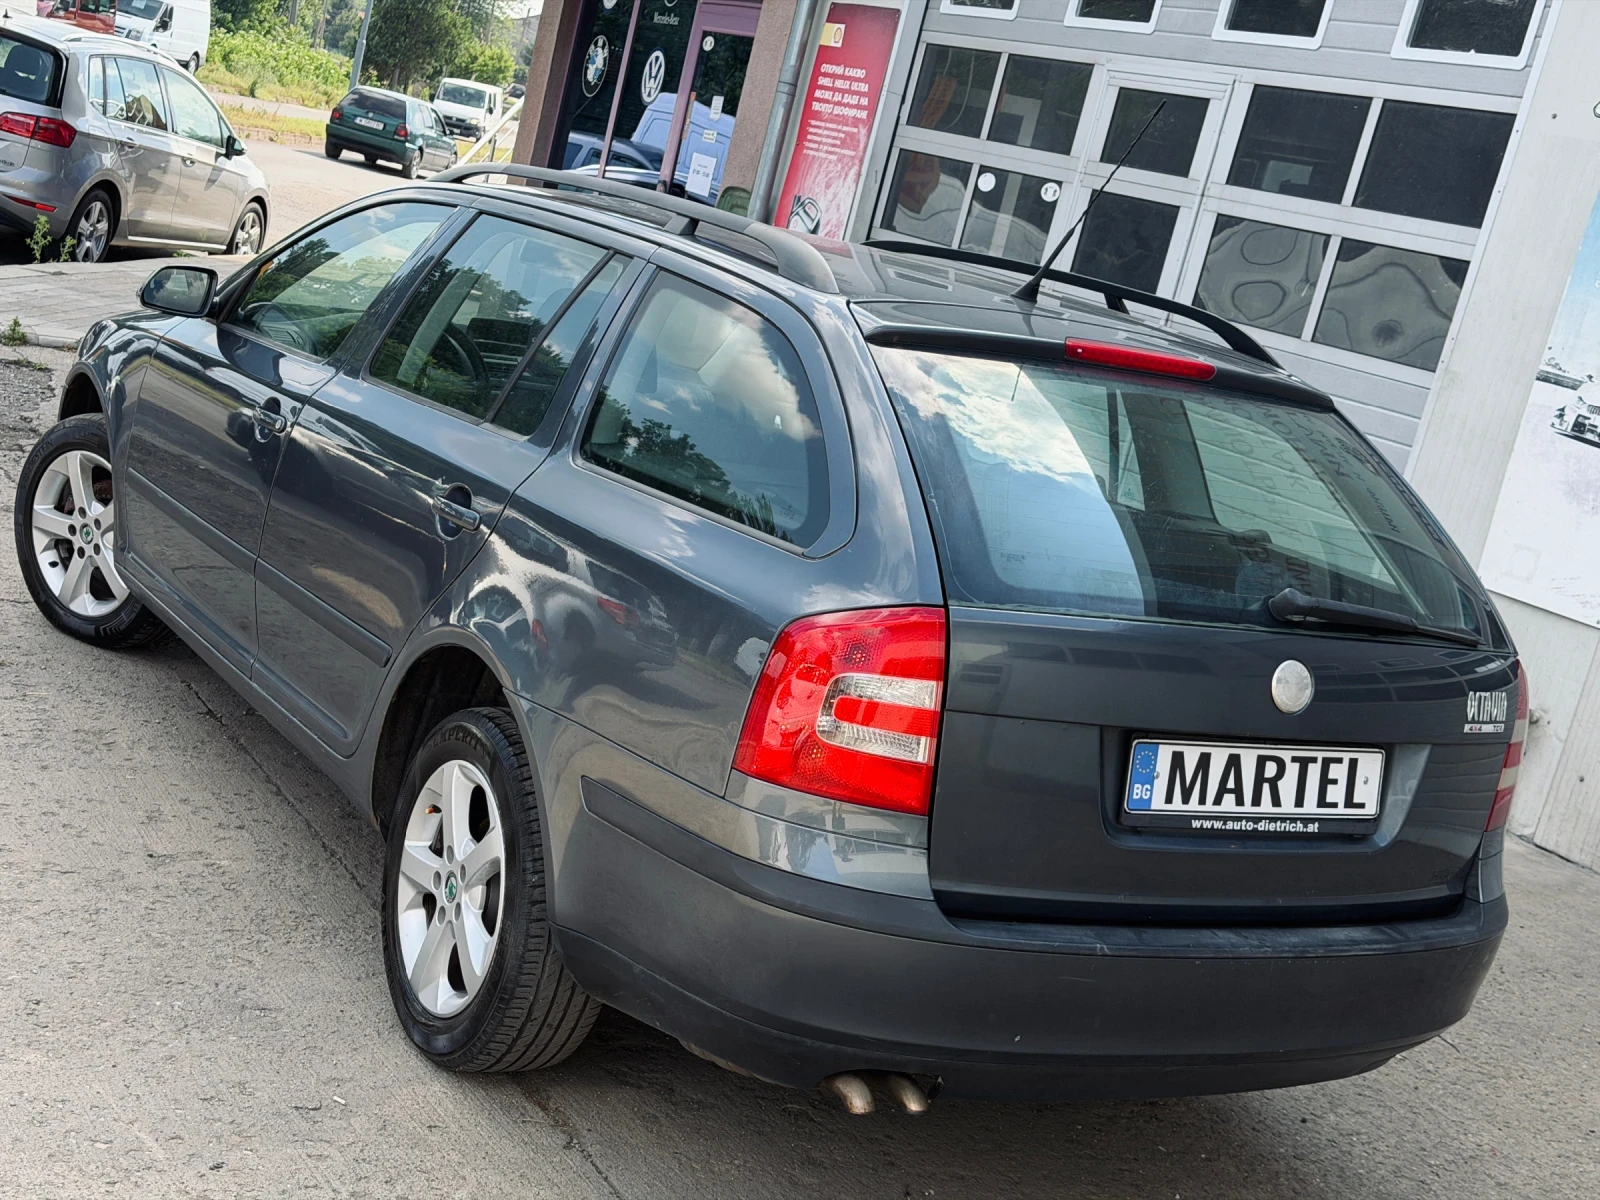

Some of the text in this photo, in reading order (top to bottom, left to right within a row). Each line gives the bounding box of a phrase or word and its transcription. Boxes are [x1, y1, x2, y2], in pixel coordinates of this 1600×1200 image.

[821, 63, 866, 78] ОТКРИЙ КАКВО
[817, 76, 869, 92] SHELL HELIX ULTRA
[814, 89, 869, 106] МОЖЕ ДА ДАДЕ НА
[812, 101, 868, 119] ТВОЕТО ШОФИРАНЕ
[1467, 691, 1507, 721] OCTAVIA
[1164, 750, 1366, 809] MARTEL
[1133, 783, 1151, 800] BG
[1191, 819, 1319, 834] www.auto-dietrich.at
